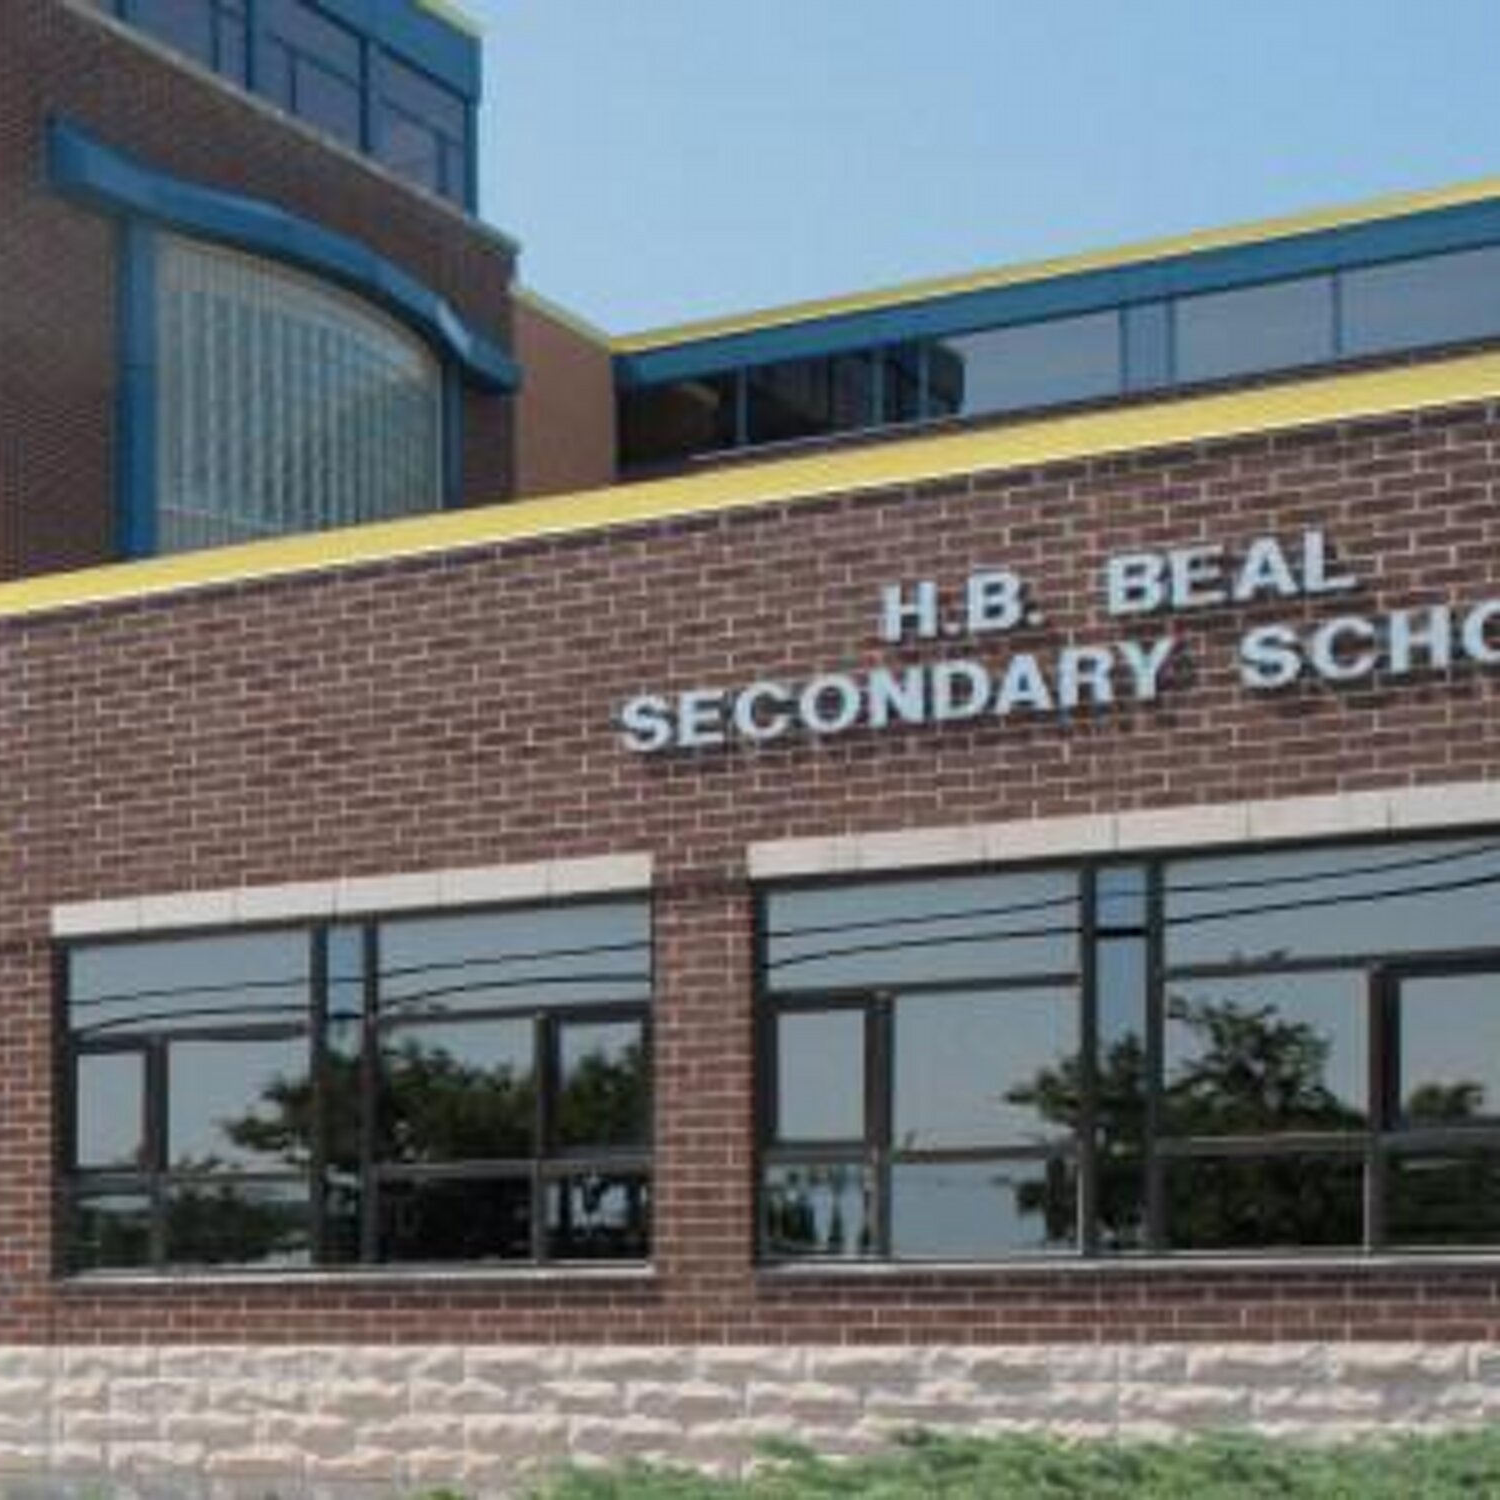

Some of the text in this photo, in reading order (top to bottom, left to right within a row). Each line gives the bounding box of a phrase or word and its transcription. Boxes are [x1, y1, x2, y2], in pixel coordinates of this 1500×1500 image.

[879, 527, 1357, 642] H.B. BEAL
[621, 637, 1174, 753] SECONDARY
